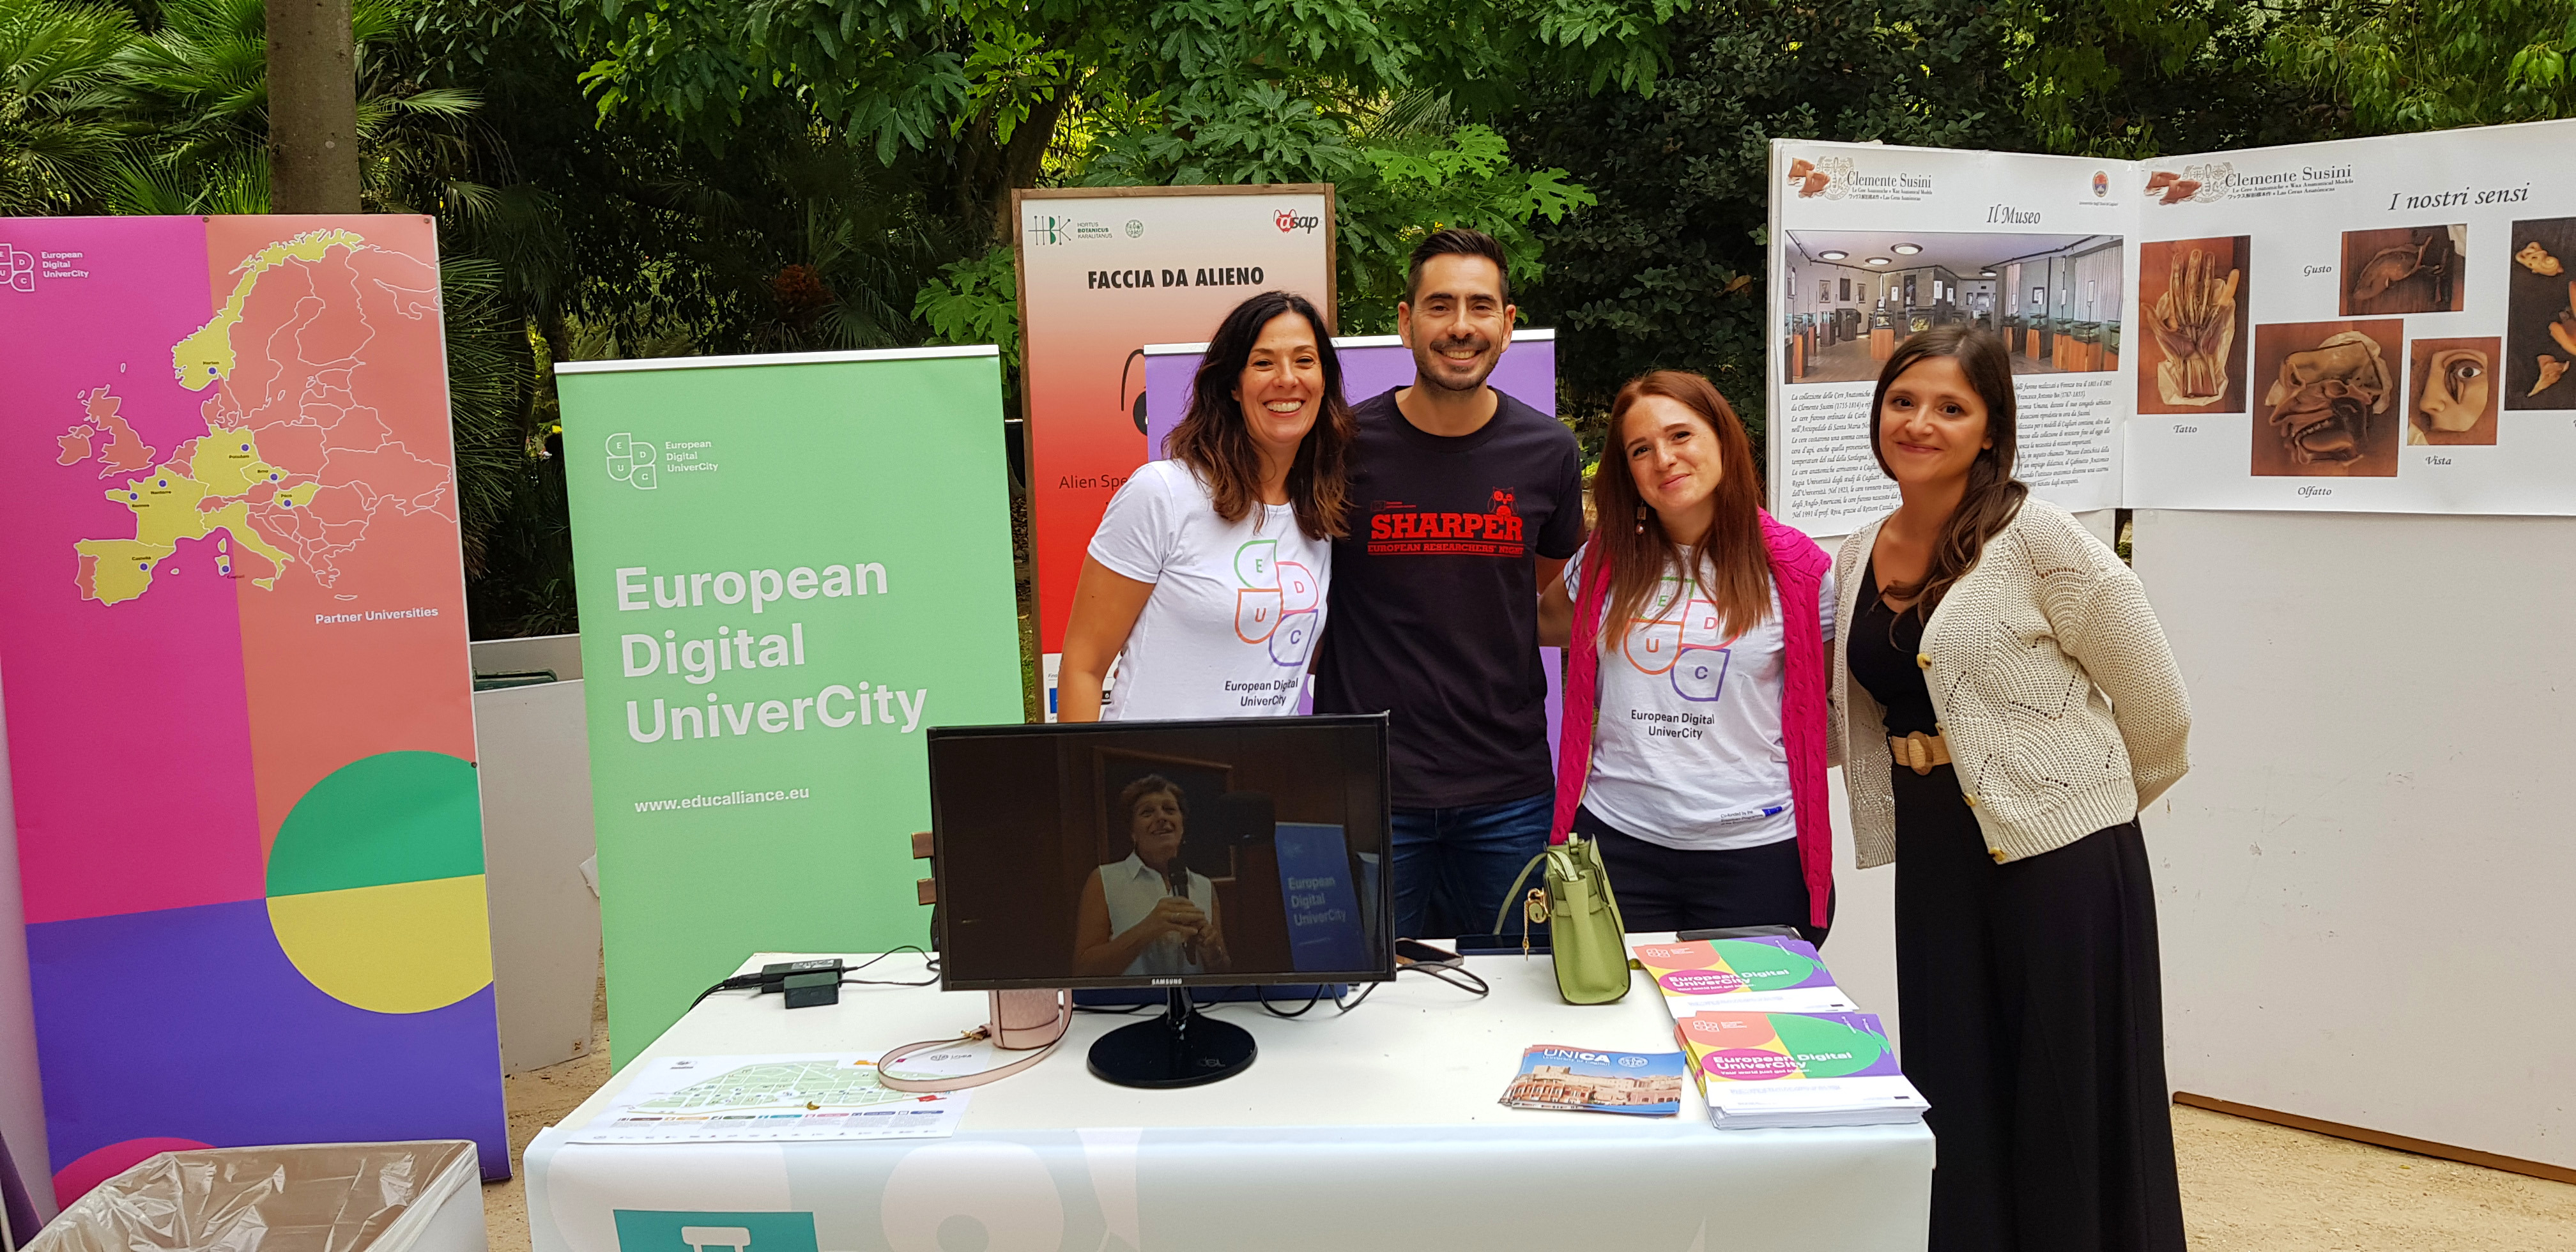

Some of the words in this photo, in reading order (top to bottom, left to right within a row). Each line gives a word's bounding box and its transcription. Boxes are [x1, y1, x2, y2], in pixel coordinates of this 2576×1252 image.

[1848, 171, 1897, 187] Clemente
[1900, 173, 1931, 188] Susini
[2225, 172, 2296, 187] Clemente
[2303, 164, 2350, 181] Susini
[2388, 193, 2402, 211] I
[2407, 187, 2468, 209] nostri
[2475, 183, 2529, 204] sensi
[1986, 204, 2001, 222] Il
[2002, 206, 2041, 224] Museo
[1279, 215, 1318, 234] asap
[42, 261, 71, 269] Digital
[2304, 264, 2332, 276] Gusto
[43, 270, 89, 279] UniverCity
[1088, 270, 1154, 289] FACCIA
[1162, 268, 1188, 287] DA
[1195, 266, 1264, 286] ALIENO
[2174, 424, 2198, 433] Tatto
[665, 440, 712, 450] European
[666, 452, 698, 461] Digital
[2425, 455, 2451, 466] Vista
[667, 462, 719, 472] UniverCity
[1059, 475, 1096, 489] Alien
[2297, 485, 2332, 497] Olfatto
[1371, 513, 1523, 541] SHARPER
[1368, 544, 1421, 553] EUROPEAN
[1255, 559, 1263, 573] E
[616, 560, 887, 614] European
[1294, 581, 1304, 593] D
[1657, 595, 1668, 607] E
[315, 611, 363, 624] Partner
[365, 607, 439, 622] Universities
[1255, 608, 1266, 622] U
[1704, 616, 1718, 629] D
[1291, 630, 1301, 644] C
[1646, 638, 1659, 652] U
[621, 623, 805, 685] Digital
[1695, 666, 1708, 680] C
[1225, 680, 1271, 693] European
[1274, 678, 1298, 692] Digital
[1241, 694, 1286, 706] UniverCity
[626, 681, 928, 743] UniverCity
[1631, 710, 1679, 723] European
[1682, 713, 1715, 726] Digital
[1648, 726, 1703, 740] UniverCity
[634, 787, 809, 813] www.educalliance.eu
[1288, 876, 1335, 890] European
[1291, 893, 1325, 908] Digital
[1294, 909, 1346, 926] UniverCity
[1741, 970, 1789, 978] Digital
[1673, 979, 1751, 987] UniverCity
[1544, 1049, 1610, 1063] UNICA
[1797, 1052, 1852, 1061] Digital
